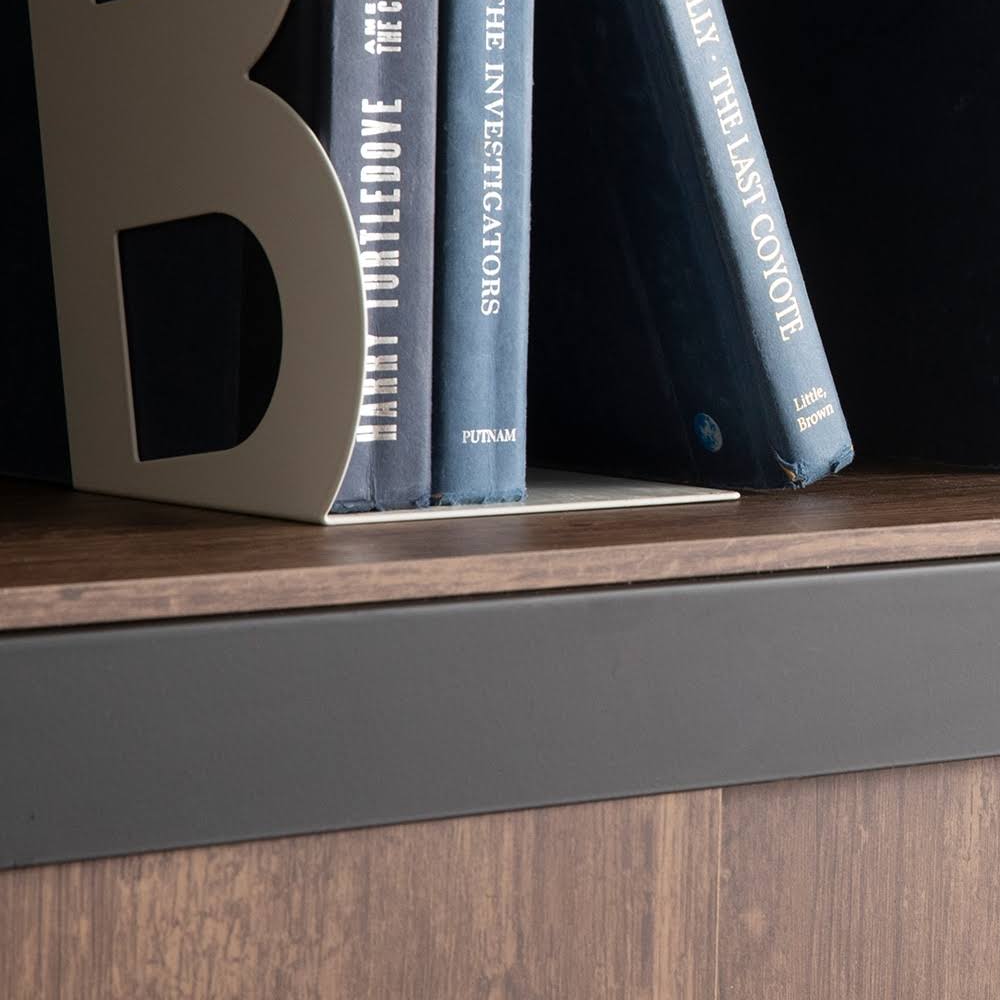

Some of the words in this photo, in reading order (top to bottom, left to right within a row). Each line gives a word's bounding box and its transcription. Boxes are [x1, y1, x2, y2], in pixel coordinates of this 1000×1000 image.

[376, 21, 403, 55] THE
[360, 98, 403, 309] TURTLEDOVE
[480, 62, 505, 316] INVESTIGATORS
[708, 66, 743, 135] THE
[726, 134, 767, 208] LAST
[750, 212, 804, 342] COYOTE
[356, 334, 398, 442] HARRY
[793, 384, 828, 413] Little,
[797, 403, 834, 433] Brown
[462, 428, 517, 444] PUTNAM
